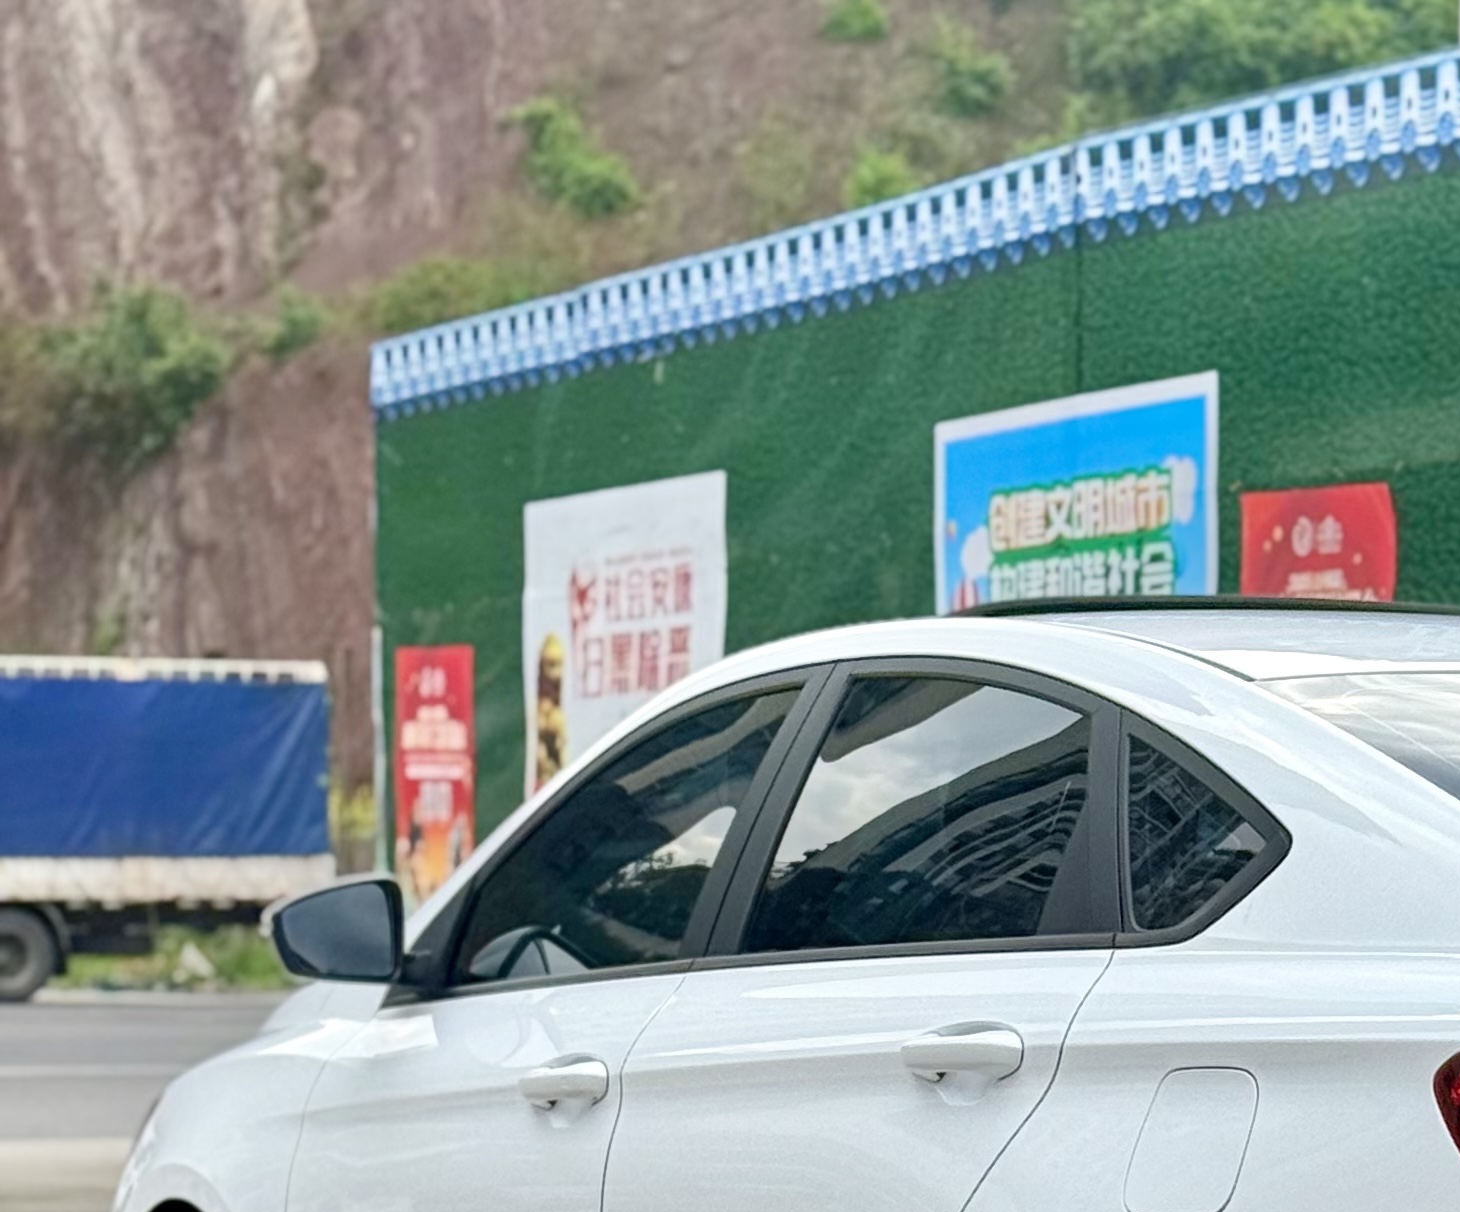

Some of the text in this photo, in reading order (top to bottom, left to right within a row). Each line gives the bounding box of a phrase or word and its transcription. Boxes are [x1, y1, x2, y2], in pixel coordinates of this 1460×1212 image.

[988, 468, 1171, 550] 创建文明城市
[988, 538, 1174, 602] 构建和谐社会
